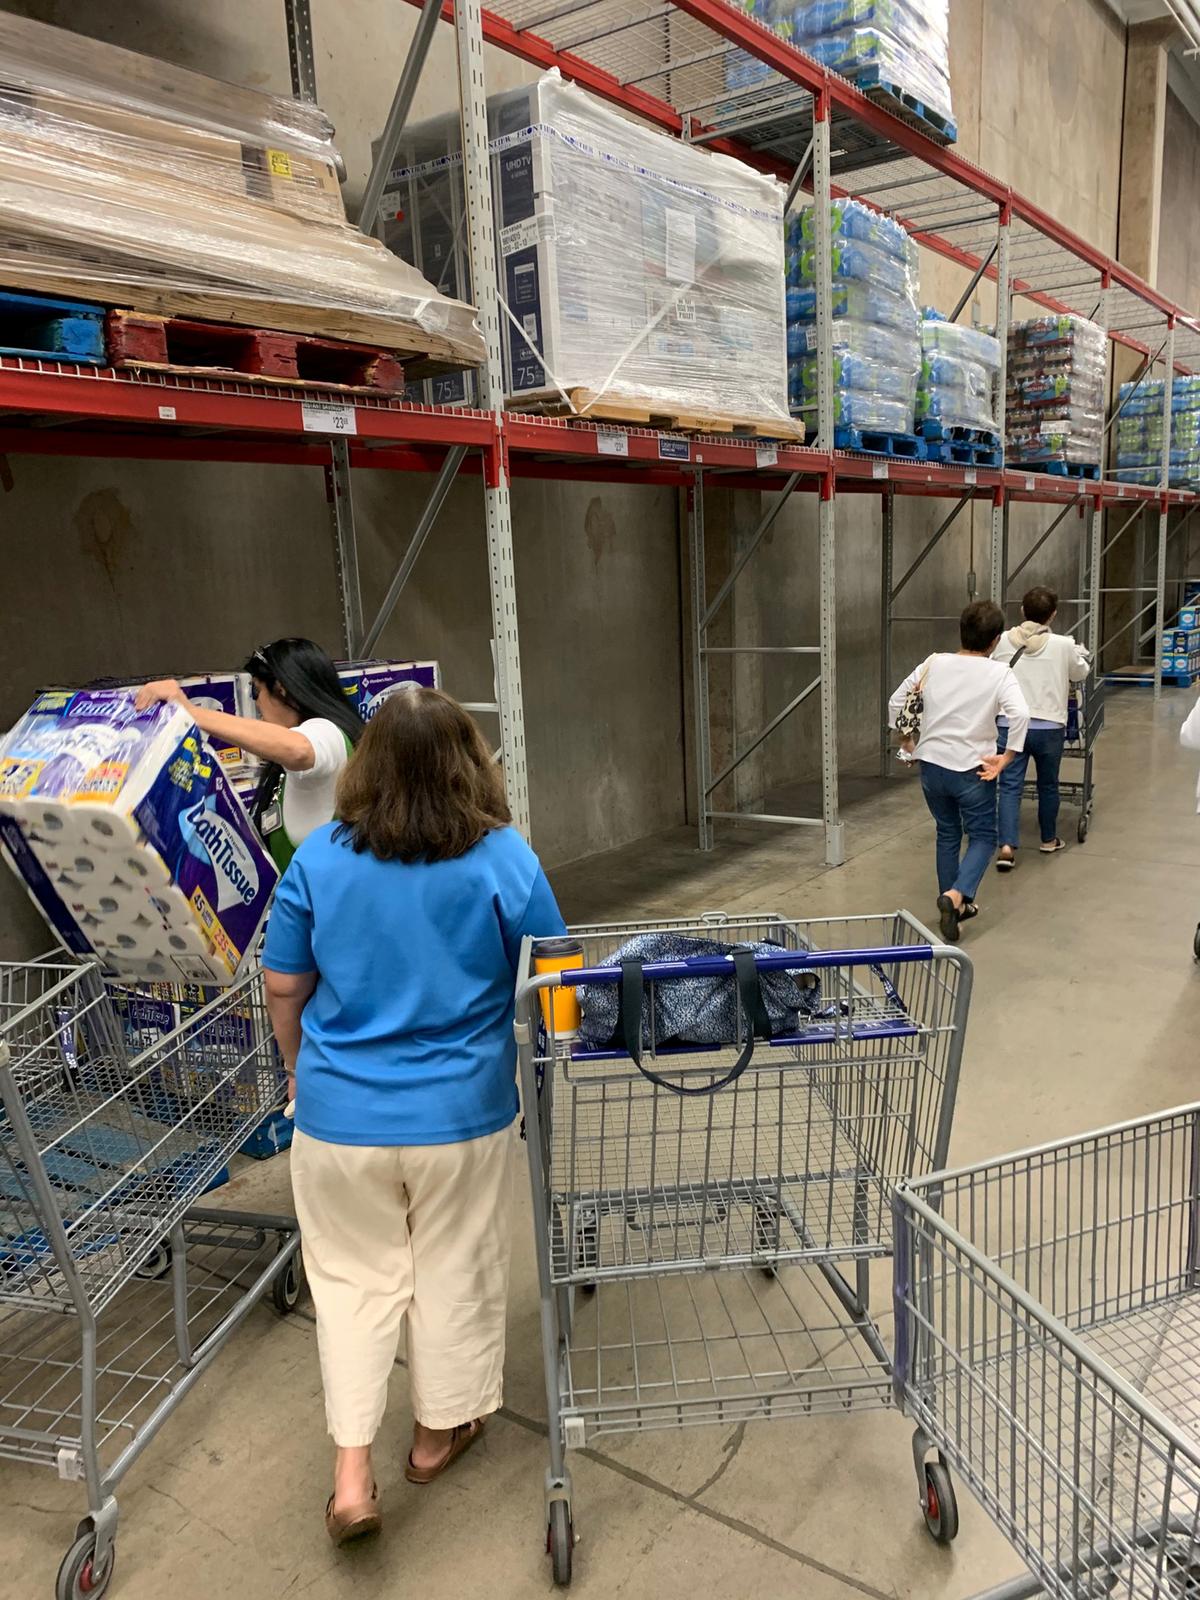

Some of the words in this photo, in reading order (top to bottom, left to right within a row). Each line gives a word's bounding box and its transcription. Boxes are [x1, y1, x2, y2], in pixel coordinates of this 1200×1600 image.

[517, 124, 556, 139] FRONTIER
[517, 366, 535, 387] 75
[436, 381, 452, 401] 75
[193, 894, 206, 912] 45
[214, 927, 230, 952] 235
